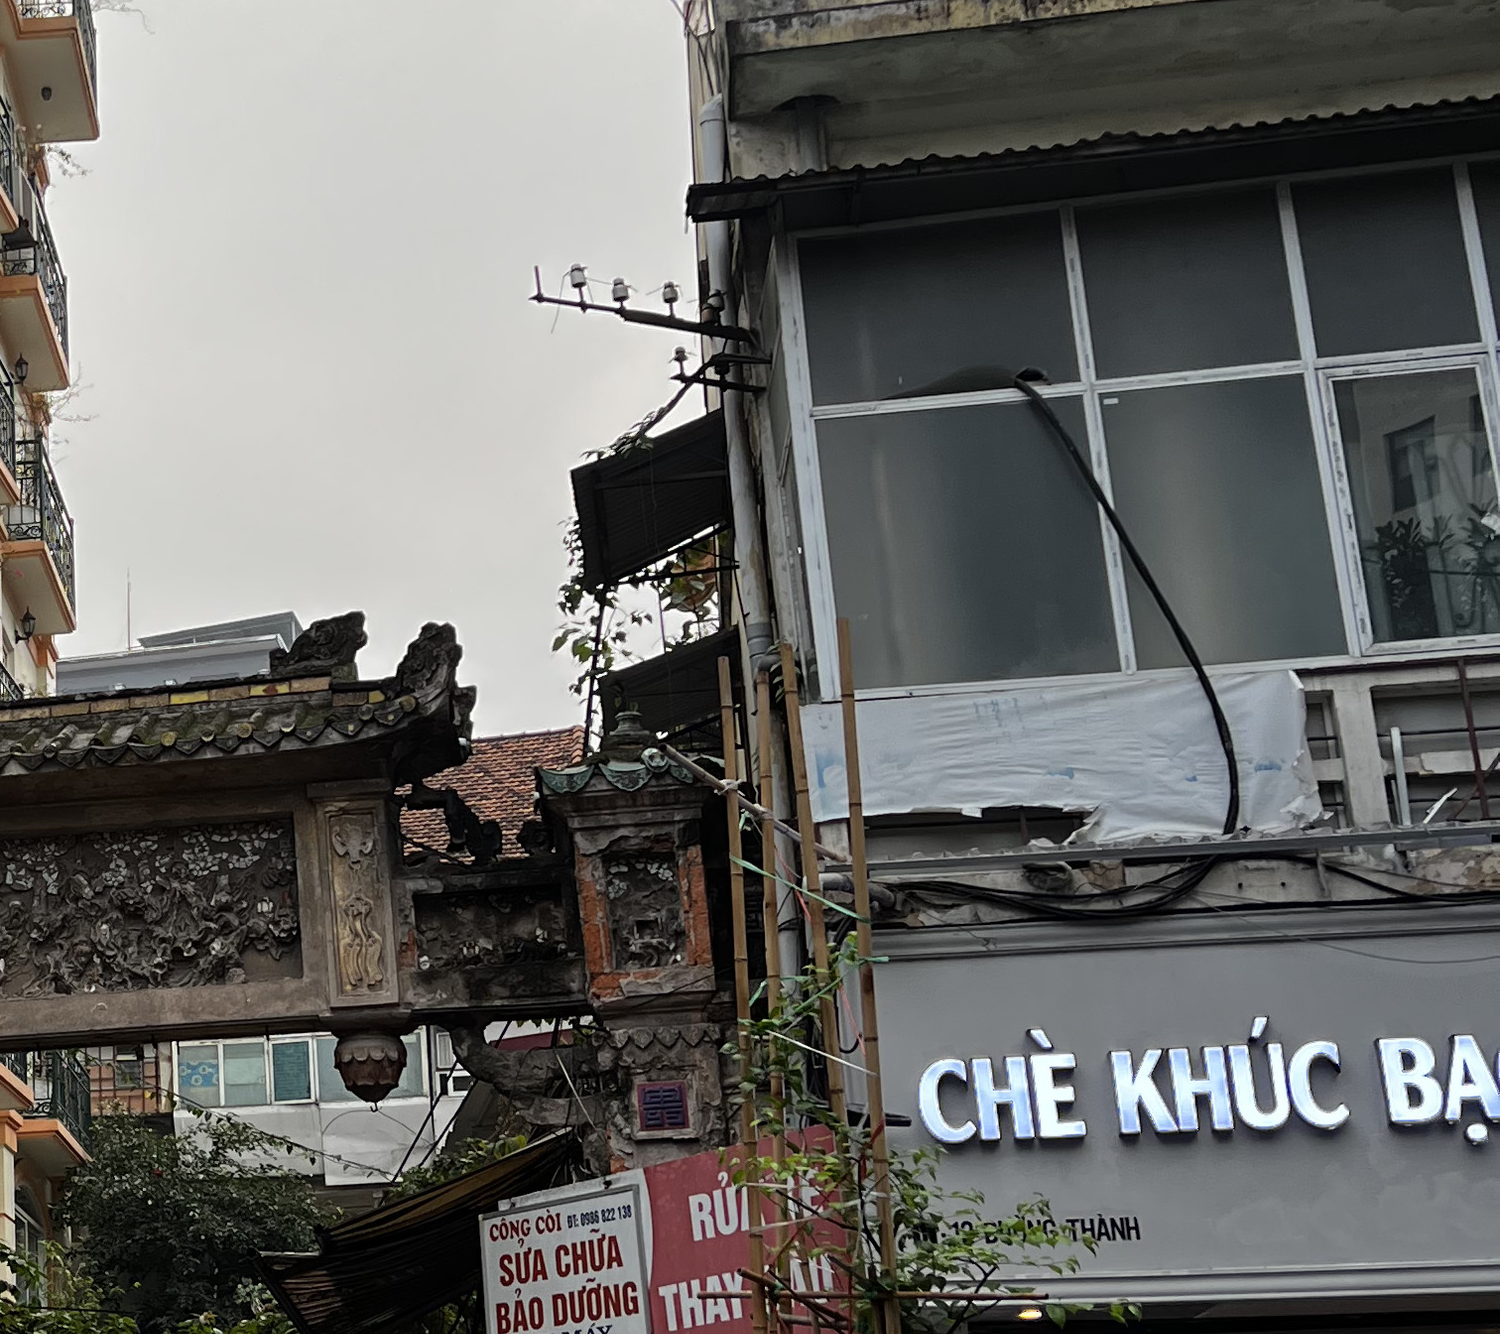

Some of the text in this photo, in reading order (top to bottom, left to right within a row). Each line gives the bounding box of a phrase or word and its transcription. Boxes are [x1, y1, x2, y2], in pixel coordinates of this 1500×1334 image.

[917, 1015, 1500, 1147] CHÈ KHÚC BẠ
[489, 1218, 531, 1242] CÔNG
[535, 1209, 562, 1235] CÒI
[499, 1228, 623, 1287] SỬA CHỮA
[496, 1278, 639, 1334] BẢO DƯỠNG
